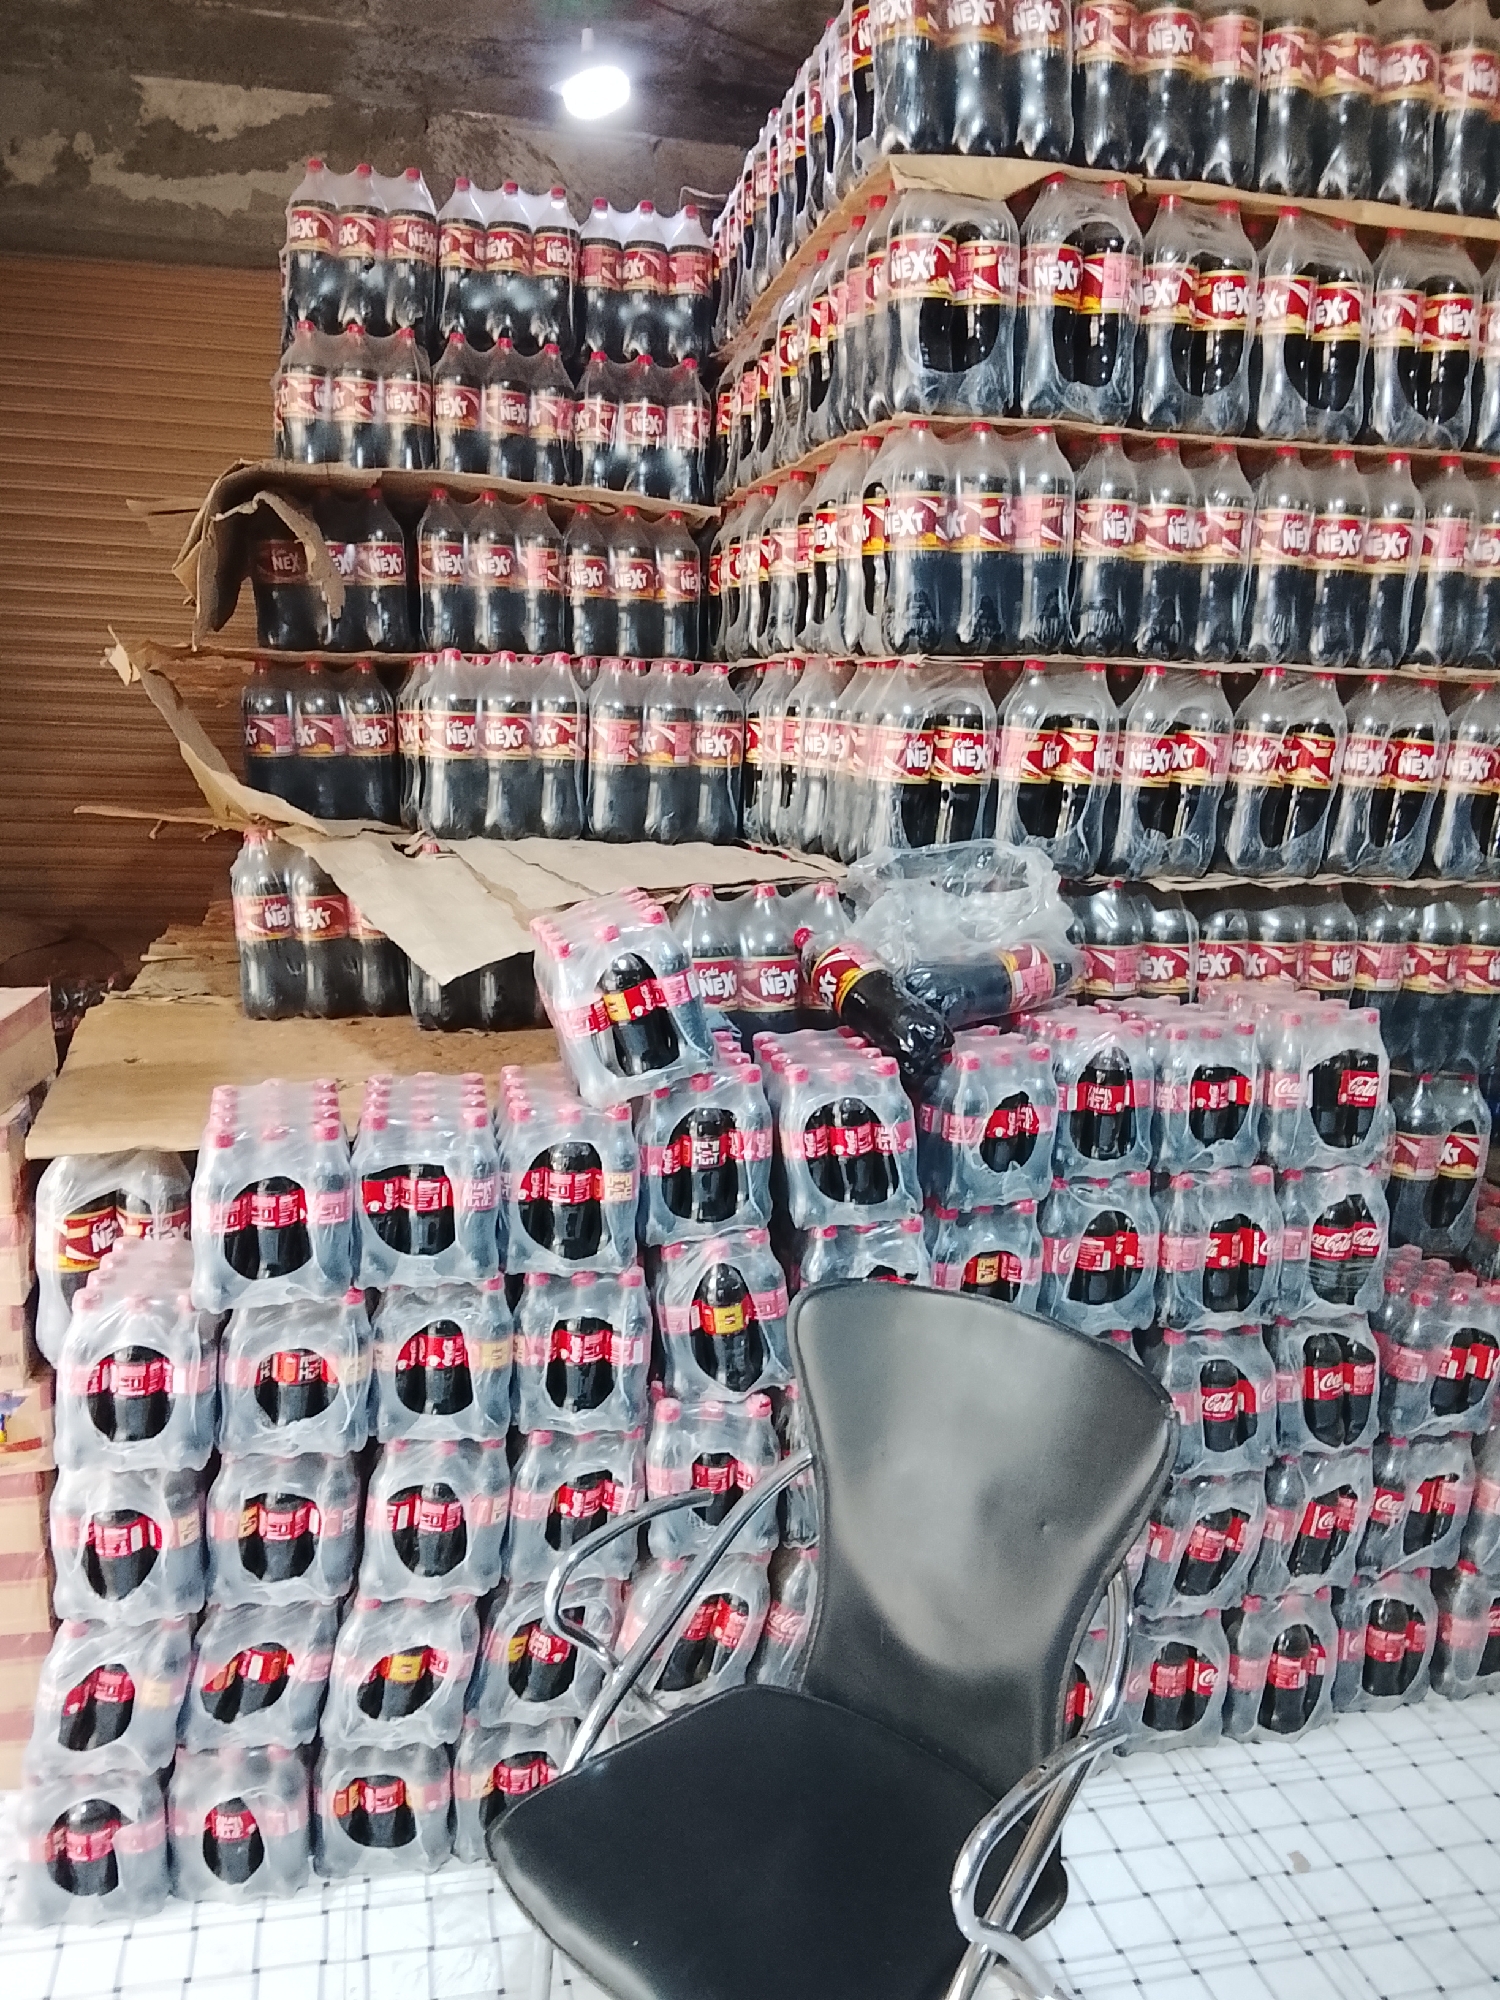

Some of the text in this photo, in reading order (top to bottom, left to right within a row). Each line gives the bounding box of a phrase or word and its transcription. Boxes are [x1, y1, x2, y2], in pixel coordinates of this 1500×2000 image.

[1013, 2, 1061, 36] NEXT
[1147, 25, 1194, 54] NEXT
[890, 250, 937, 283] NEXT
[1034, 262, 1079, 290] NEXT
[1316, 298, 1350, 327] EXT
[385, 390, 418, 412] NEXT
[435, 395, 469, 418] NEXT
[1168, 519, 1207, 548] NEXT
[1316, 529, 1363, 559] NEXT
[369, 554, 402, 576] NEXT
[476, 555, 511, 577] NEXT
[570, 566, 604, 588] NEXT
[615, 568, 648, 590] NEXT
[351, 724, 387, 747] NEXT
[485, 725, 524, 748] NEXT
[696, 734, 733, 757] NEXT
[1129, 748, 1172, 774] NEXT
[1344, 749, 1388, 776] NEXT
[1446, 754, 1491, 781] NEXT
[699, 966, 719, 979] Cola
[761, 966, 781, 978] Cola
